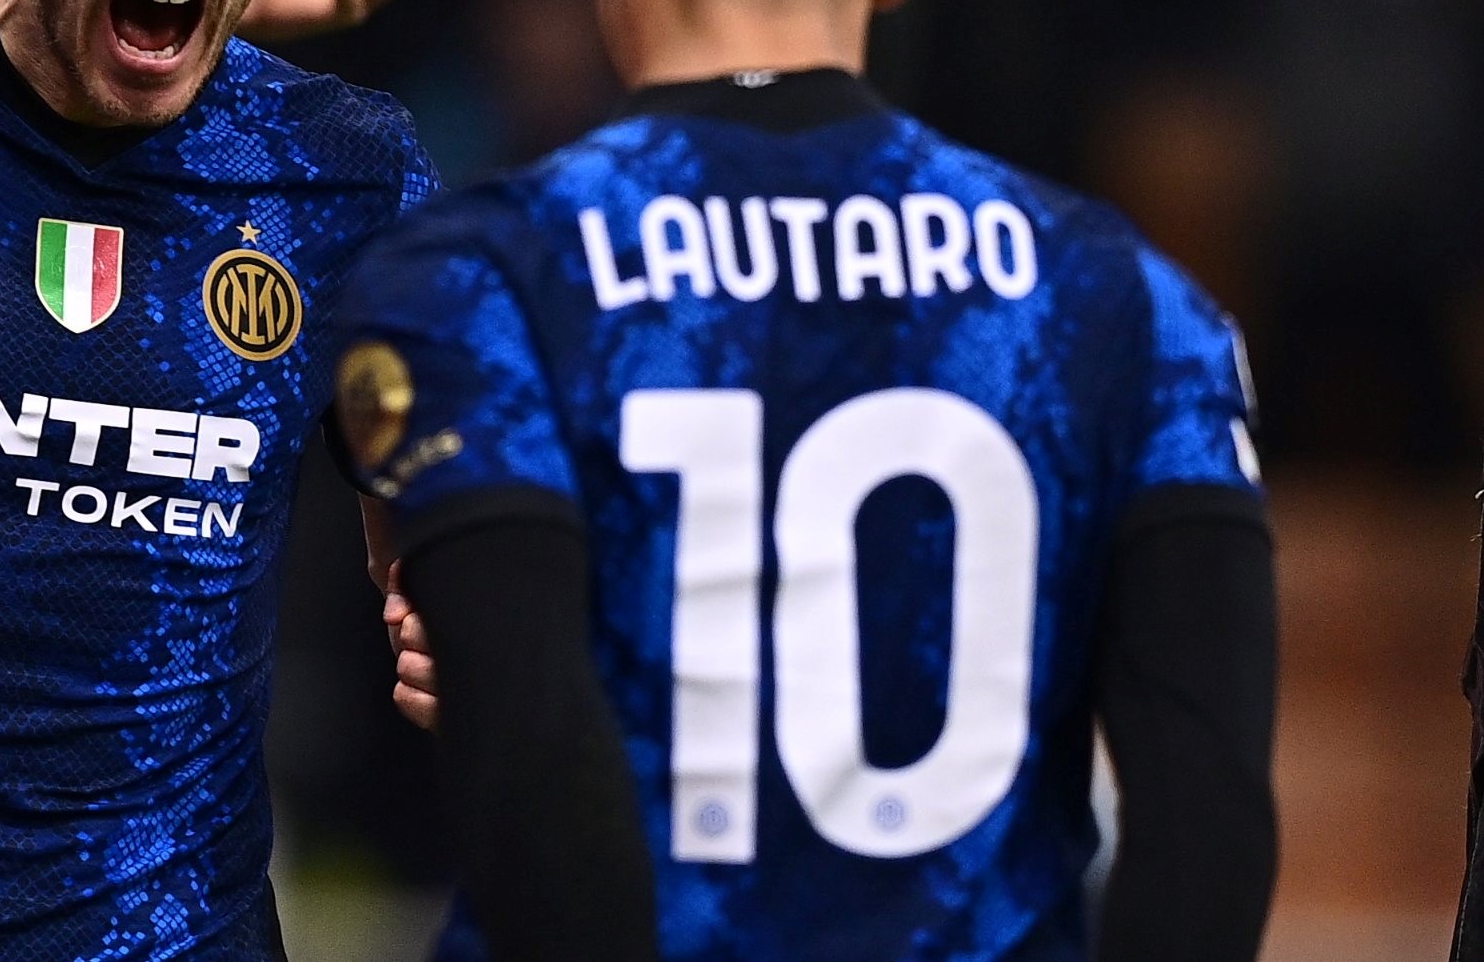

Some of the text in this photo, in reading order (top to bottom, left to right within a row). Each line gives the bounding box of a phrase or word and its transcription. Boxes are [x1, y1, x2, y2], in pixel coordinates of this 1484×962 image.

[578, 192, 1038, 311] LAUTARO
[16, 478, 244, 539] TOKEN
[619, 387, 1039, 863] 10
